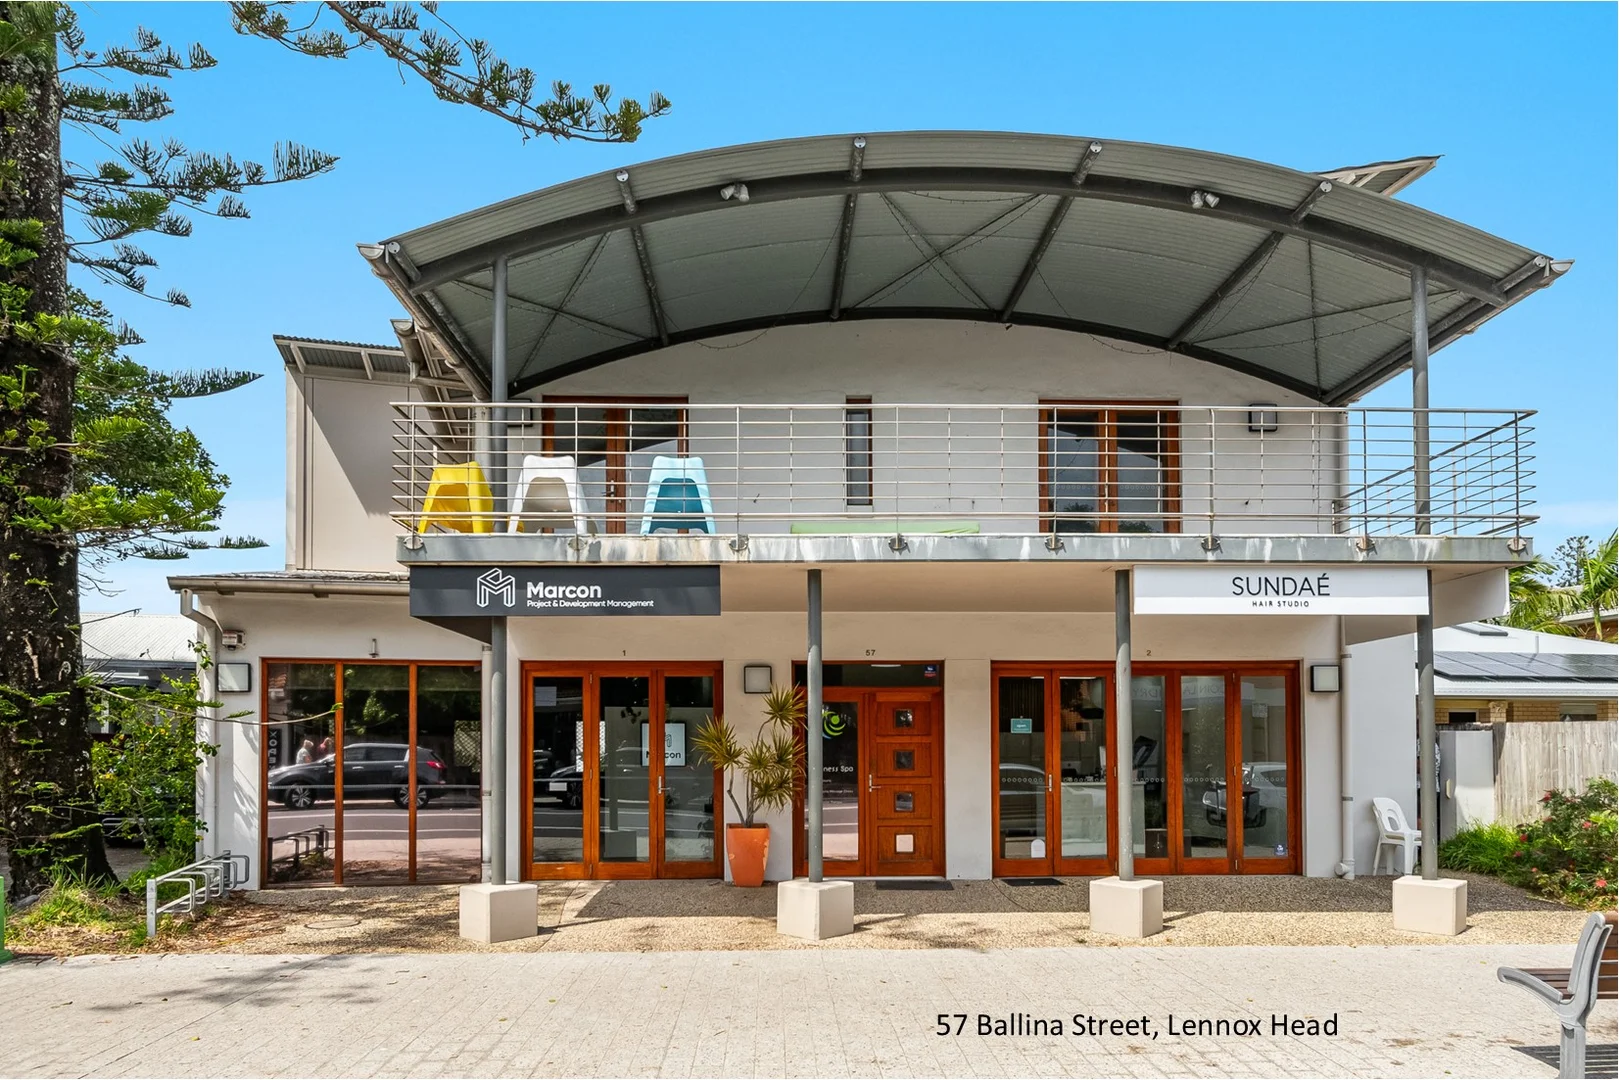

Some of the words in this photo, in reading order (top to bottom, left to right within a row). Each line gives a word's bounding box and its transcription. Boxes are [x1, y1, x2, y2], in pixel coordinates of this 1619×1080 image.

[1232, 573, 1330, 596] SUNDAÉ
[526, 581, 602, 599] Marcon
[526, 600, 551, 609] Project
[559, 600, 606, 609] Development
[607, 600, 654, 609] Management
[865, 649, 876, 657] 57
[1146, 649, 1152, 657] 2
[840, 765, 854, 773] Spa
